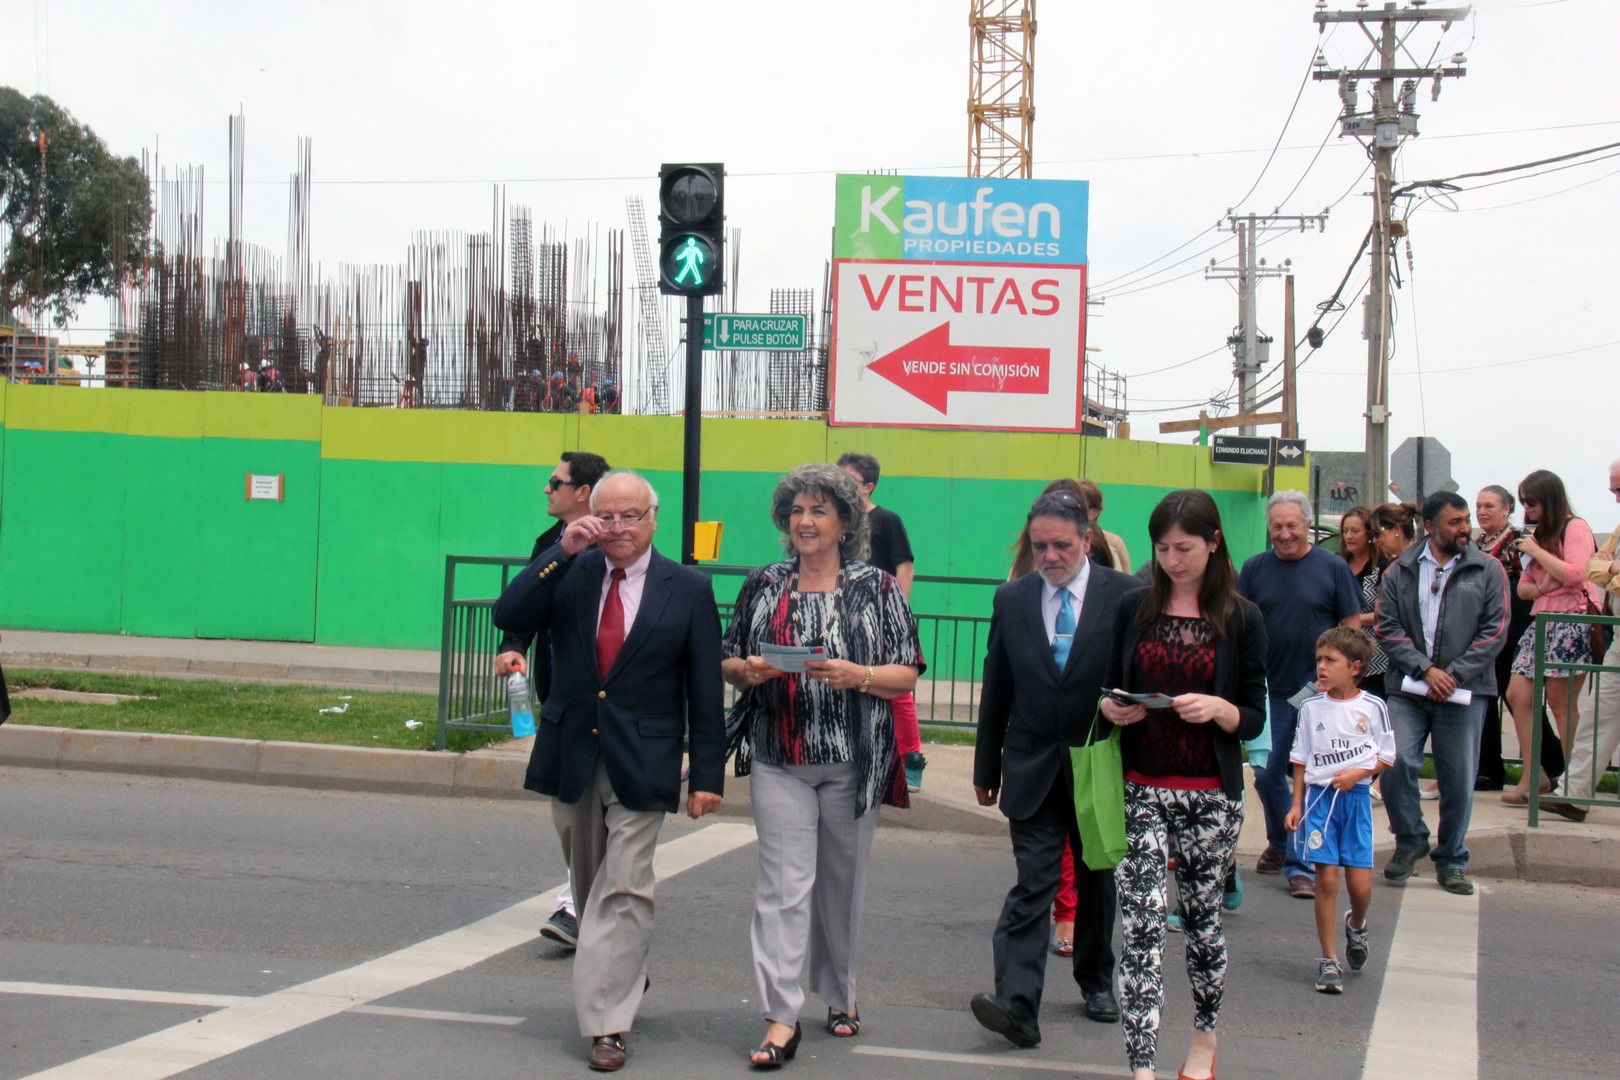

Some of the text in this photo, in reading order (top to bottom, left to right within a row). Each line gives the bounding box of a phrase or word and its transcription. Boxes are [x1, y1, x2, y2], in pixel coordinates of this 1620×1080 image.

[860, 185, 1060, 239] Kaufen
[904, 238, 1060, 256] PROPIEDADES
[858, 273, 1060, 316] VENTAS
[733, 319, 799, 331] PARA CRUZAR
[732, 332, 799, 345] PULSE BOTÓN
[902, 360, 1040, 377] VENDE SIN COMISIÓN
[1331, 739, 1350, 749] Fly
[1314, 741, 1372, 766] Emirates
